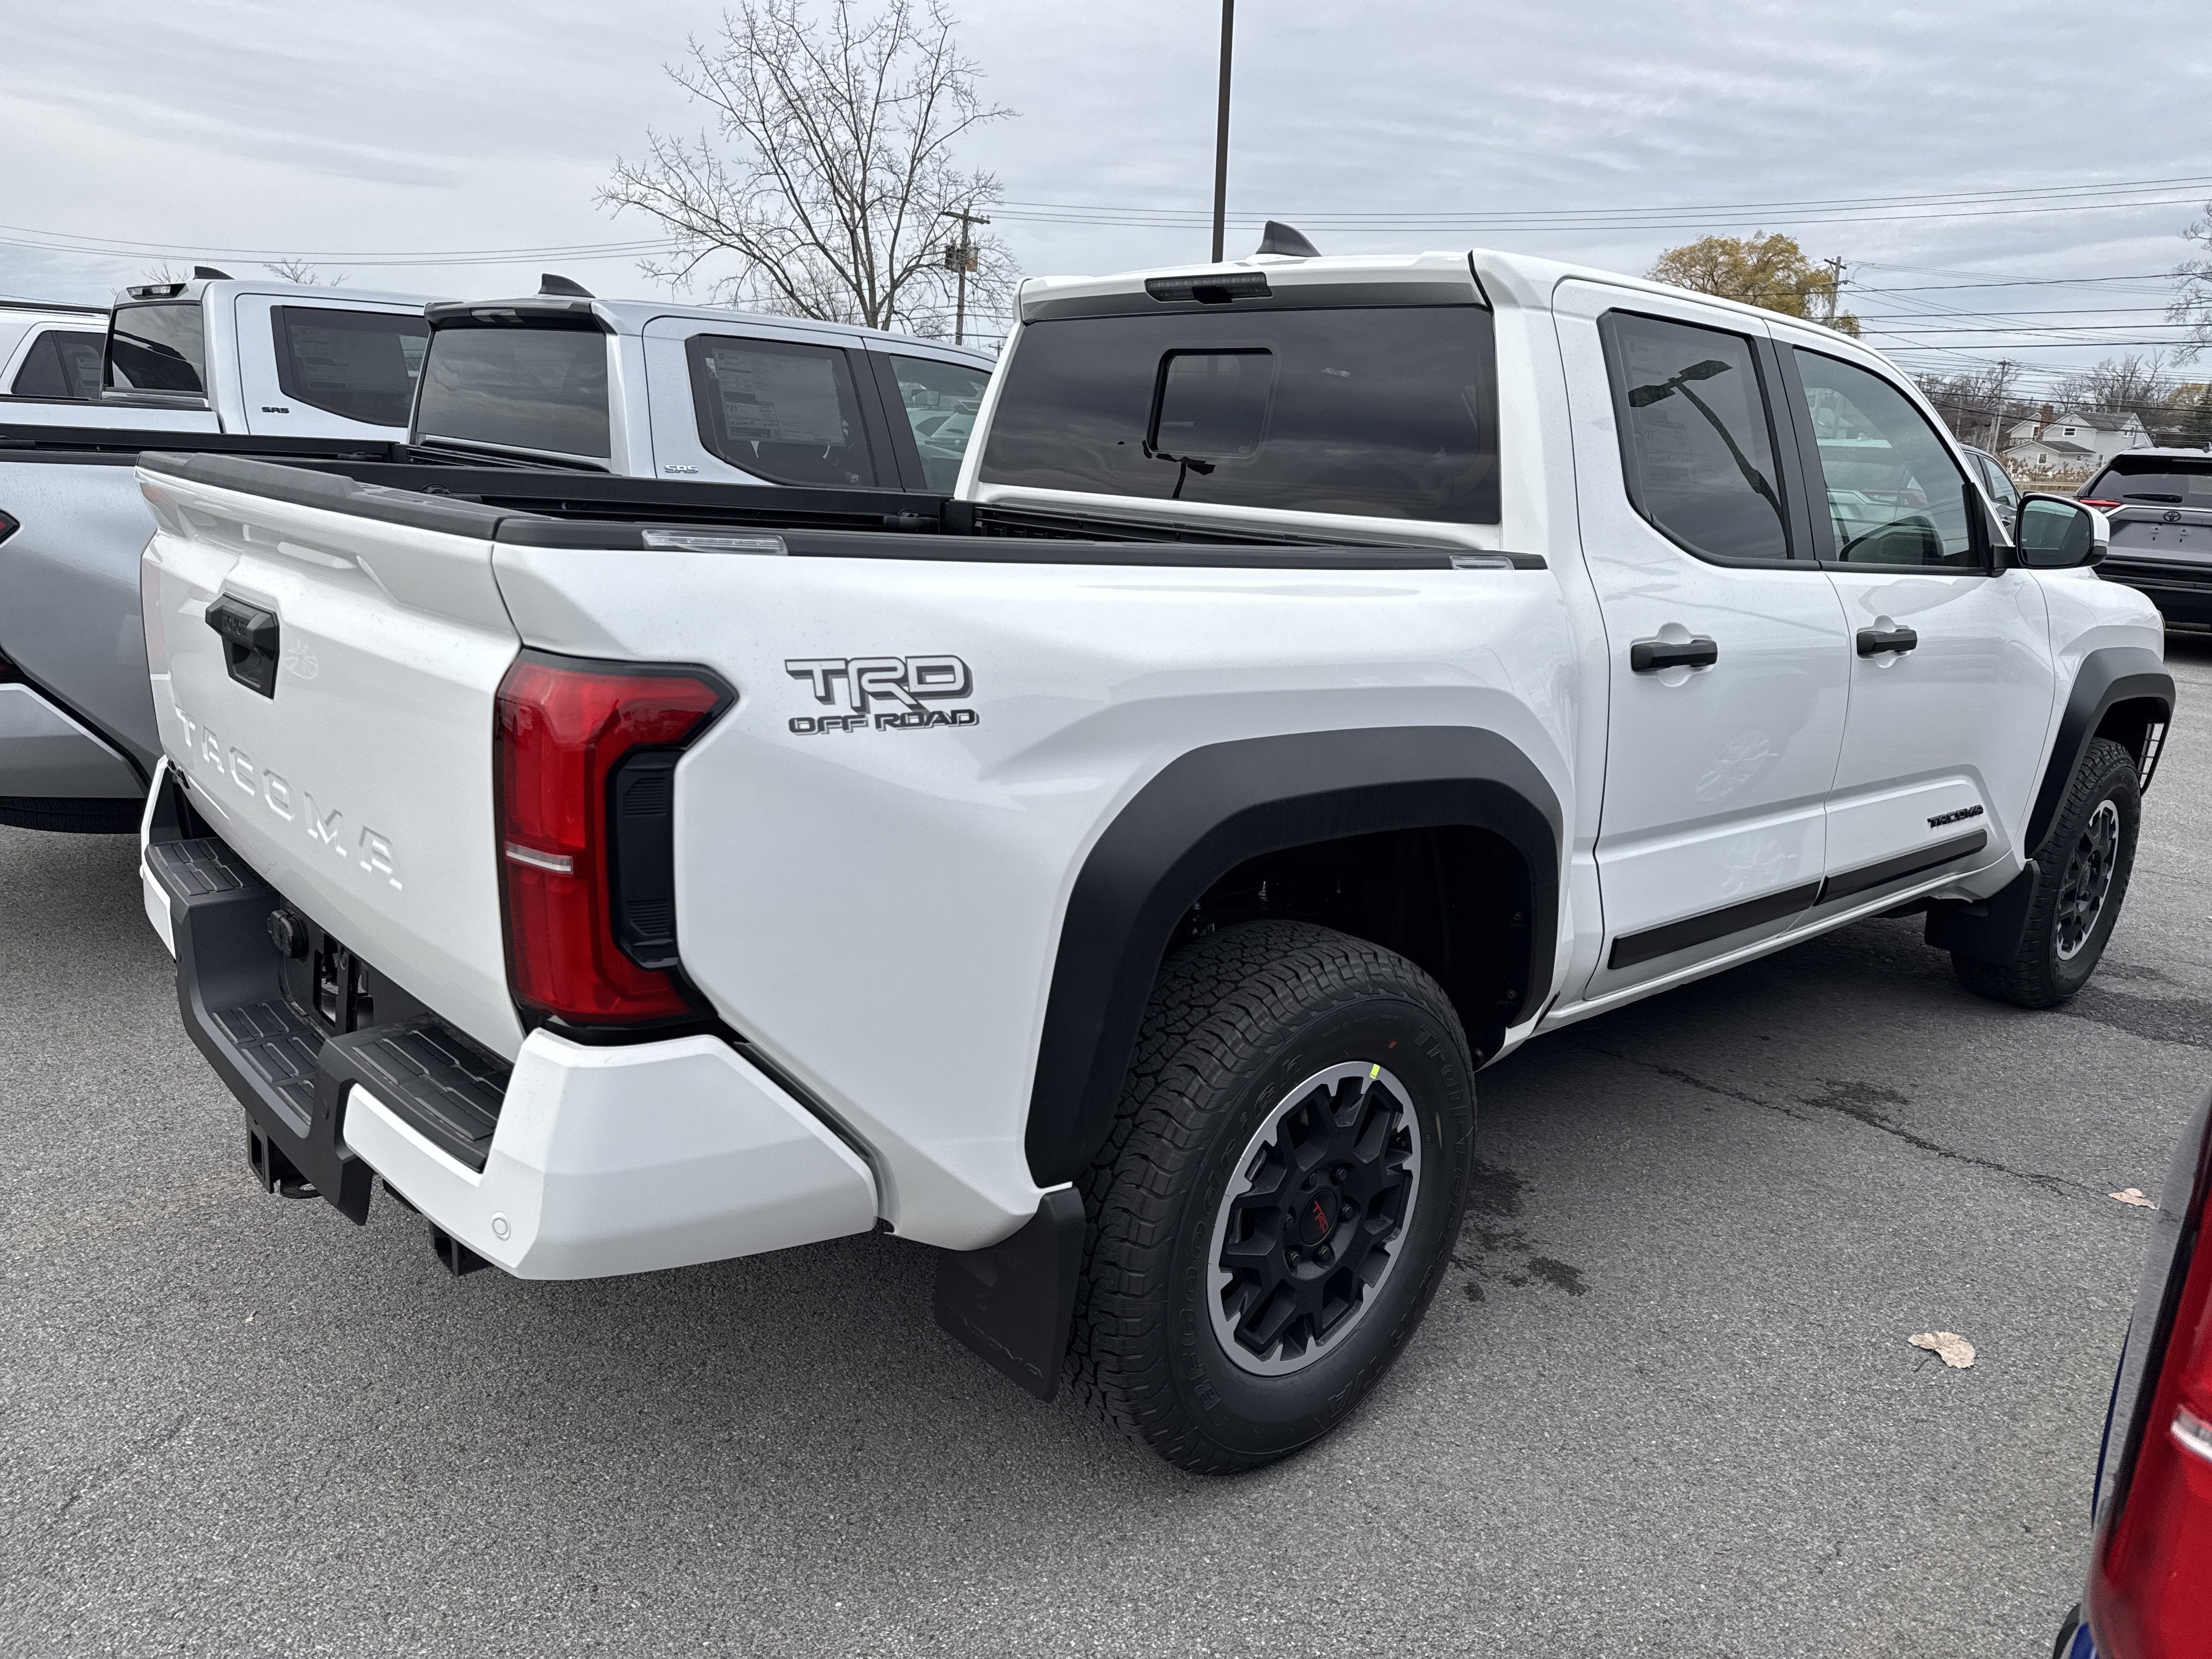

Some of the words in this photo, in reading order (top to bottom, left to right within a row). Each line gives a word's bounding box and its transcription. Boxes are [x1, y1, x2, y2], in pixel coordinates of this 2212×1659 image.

[664, 465, 698, 473] SR5
[223, 612, 248, 637] TOYOT
[785, 654, 974, 715] TRD
[788, 714, 870, 736] OFF
[874, 709, 980, 731] ROAD
[174, 703, 403, 891] TACOMA
[1927, 804, 1984, 828] TACOMA
[1179, 1052, 1304, 1411] BFGoodrich
[1312, 1200, 1329, 1233] TRD
